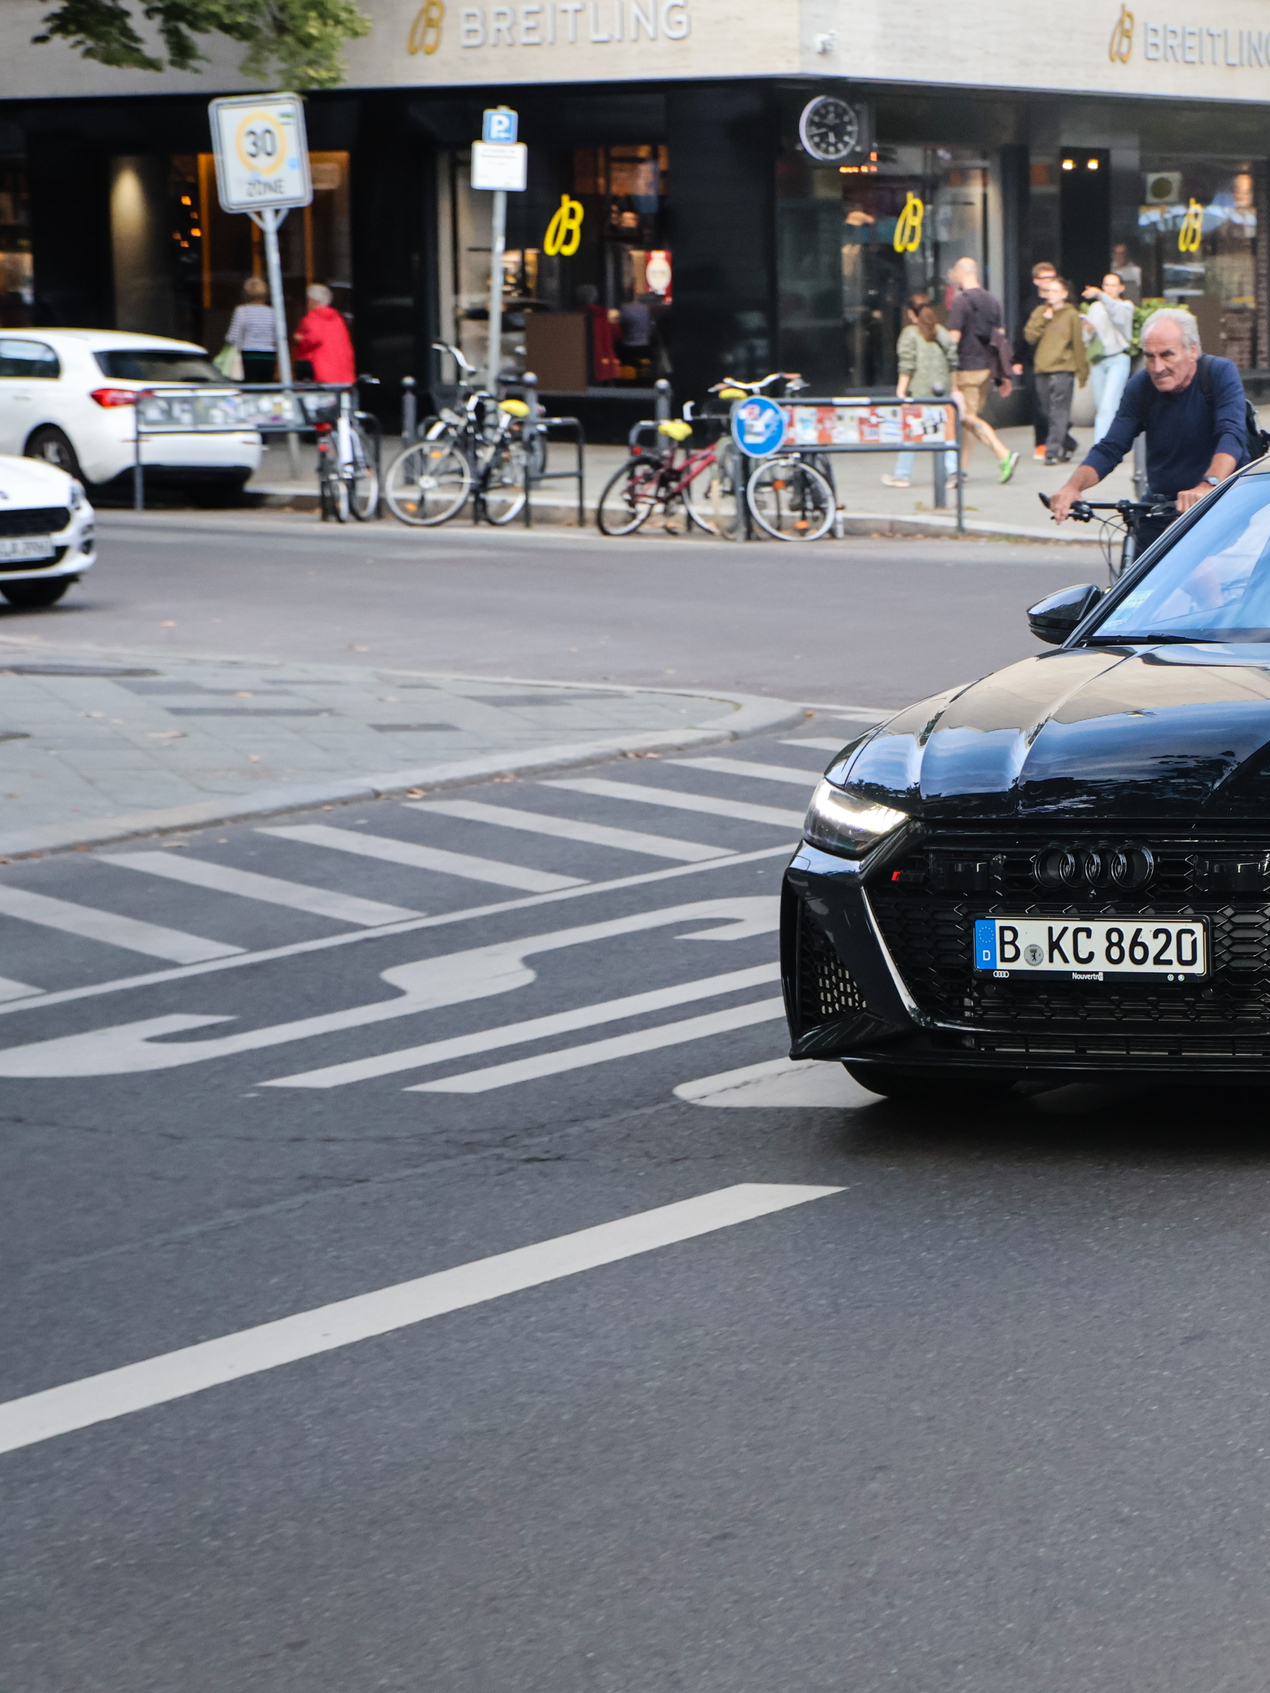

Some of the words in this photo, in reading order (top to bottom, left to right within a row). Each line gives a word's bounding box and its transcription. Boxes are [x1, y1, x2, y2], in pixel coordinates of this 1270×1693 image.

[461, 0, 692, 48] BREITLING
[245, 128, 277, 158] 30
[246, 179, 285, 198] ZONE
[982, 949, 991, 961] D
[998, 925, 1022, 963] B
[1047, 925, 1096, 965] KC
[1104, 927, 1199, 967] 8620
